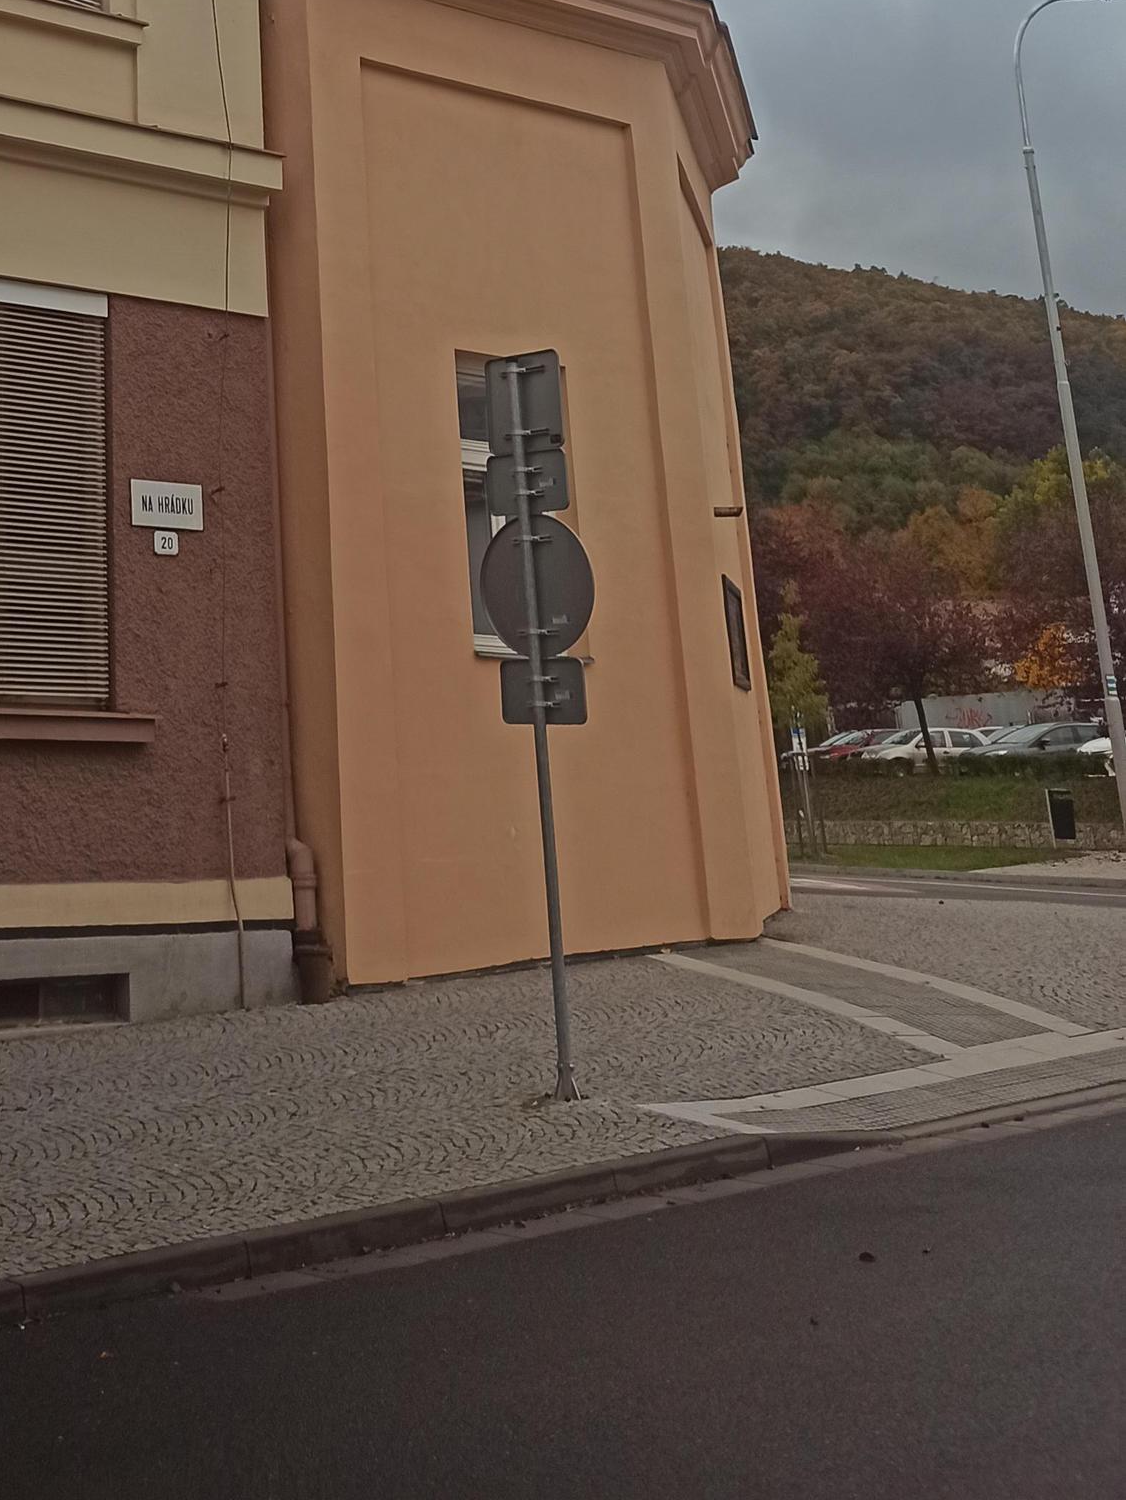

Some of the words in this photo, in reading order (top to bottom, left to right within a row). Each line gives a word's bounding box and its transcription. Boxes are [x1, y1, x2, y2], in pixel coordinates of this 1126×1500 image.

[141, 495, 154, 512] NA
[157, 493, 194, 515] HRÁDKU
[161, 536, 174, 550] 20
